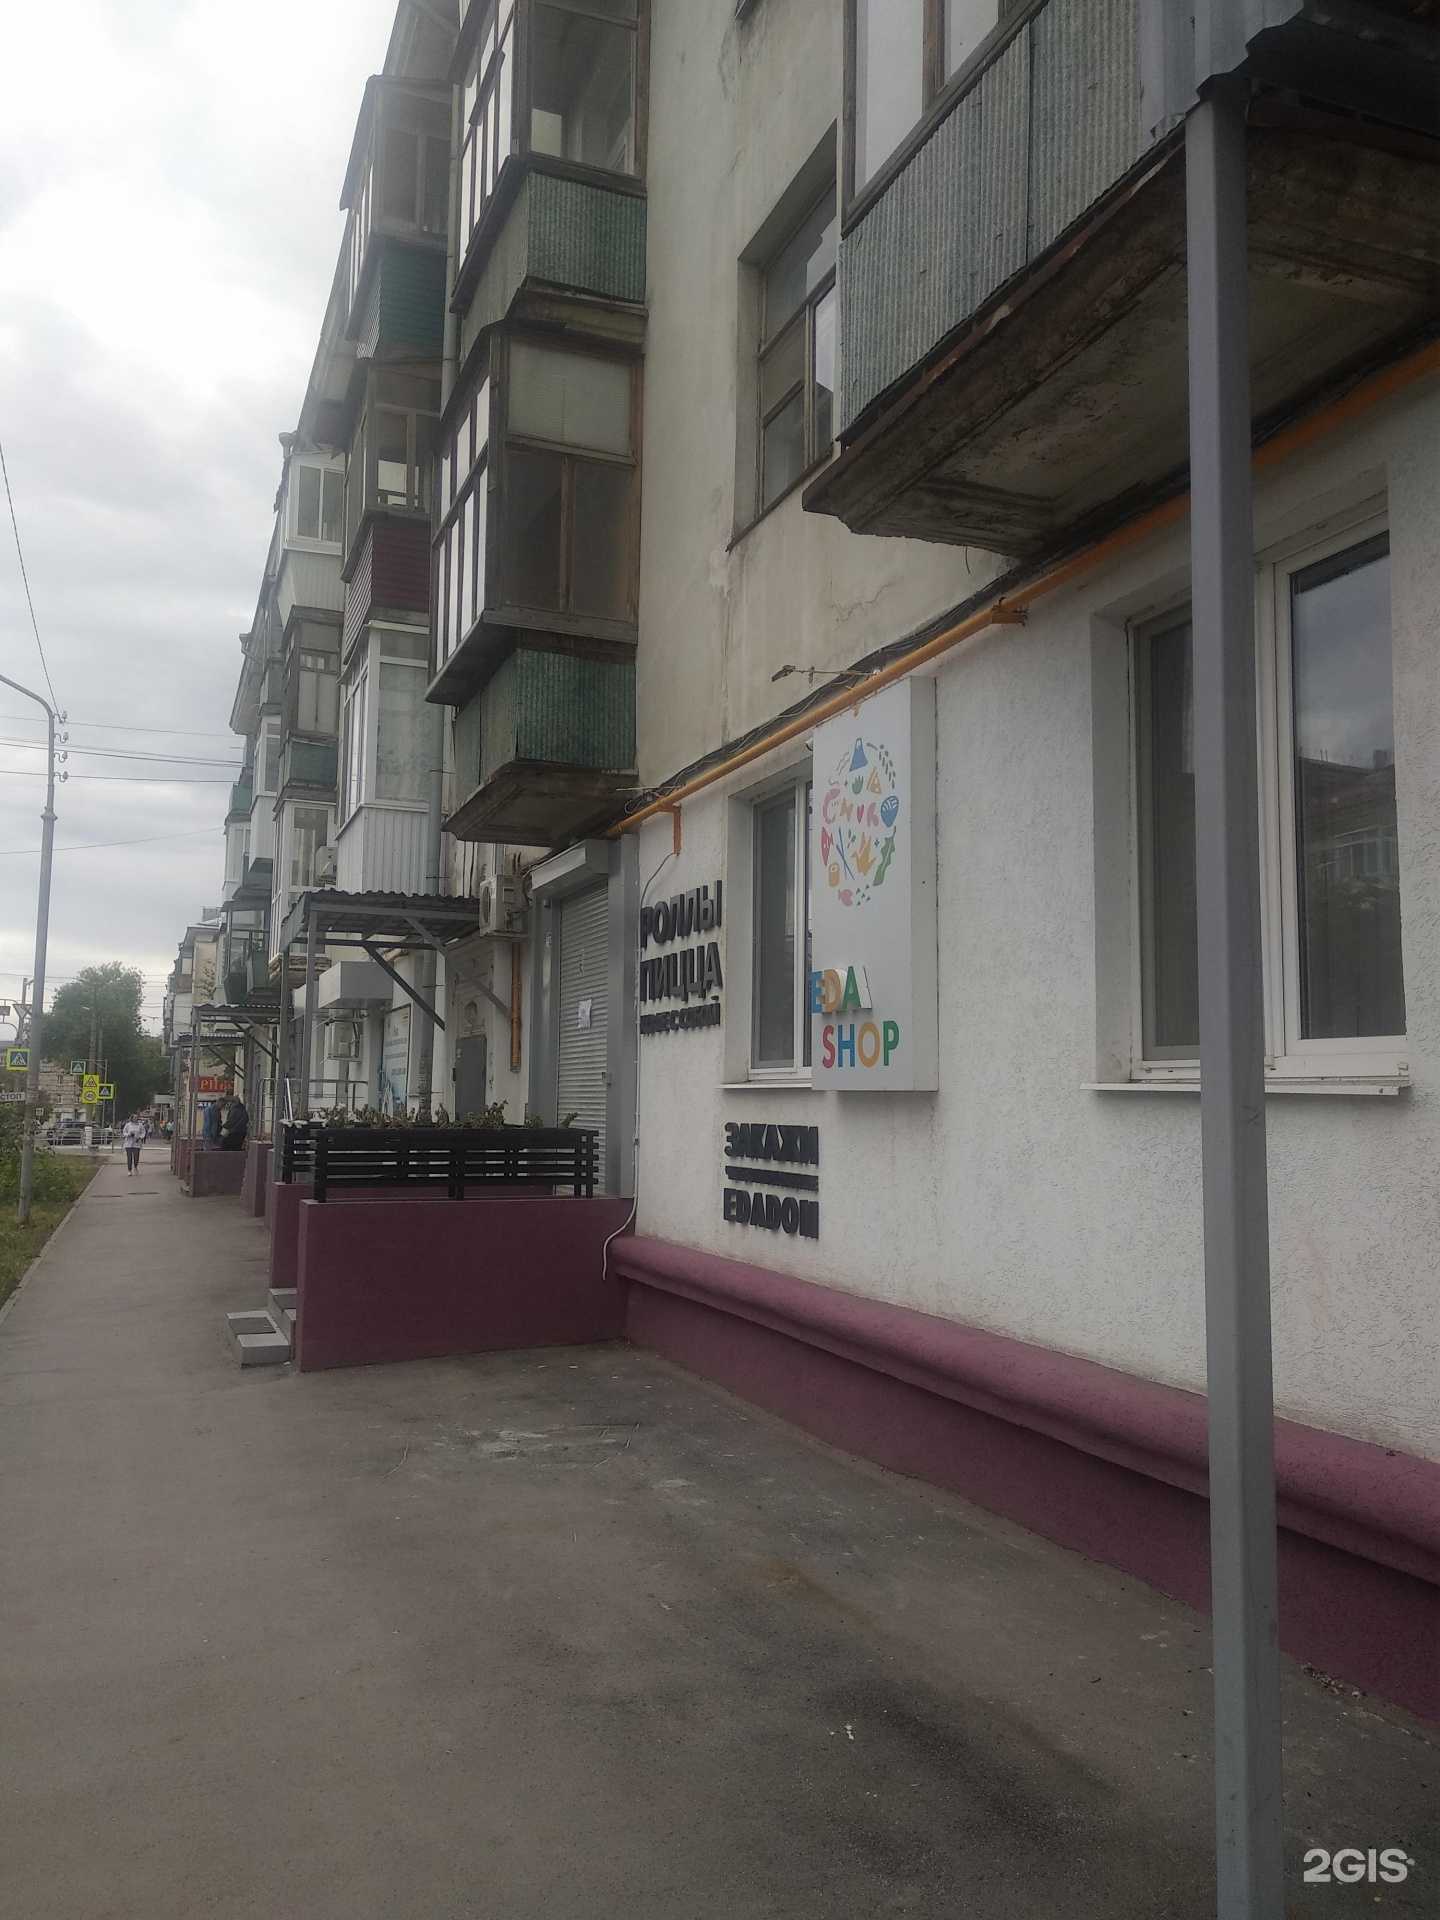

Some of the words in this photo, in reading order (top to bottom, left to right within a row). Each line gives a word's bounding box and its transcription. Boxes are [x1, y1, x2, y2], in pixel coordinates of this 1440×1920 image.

[640, 880, 722, 948] РОЛЛЫ
[640, 942, 723, 1003] ПИЦЦА
[811, 966, 862, 1013] EDA
[822, 1020, 899, 1068] SHOP
[724, 1122, 818, 1164] ЗАКАЖИ
